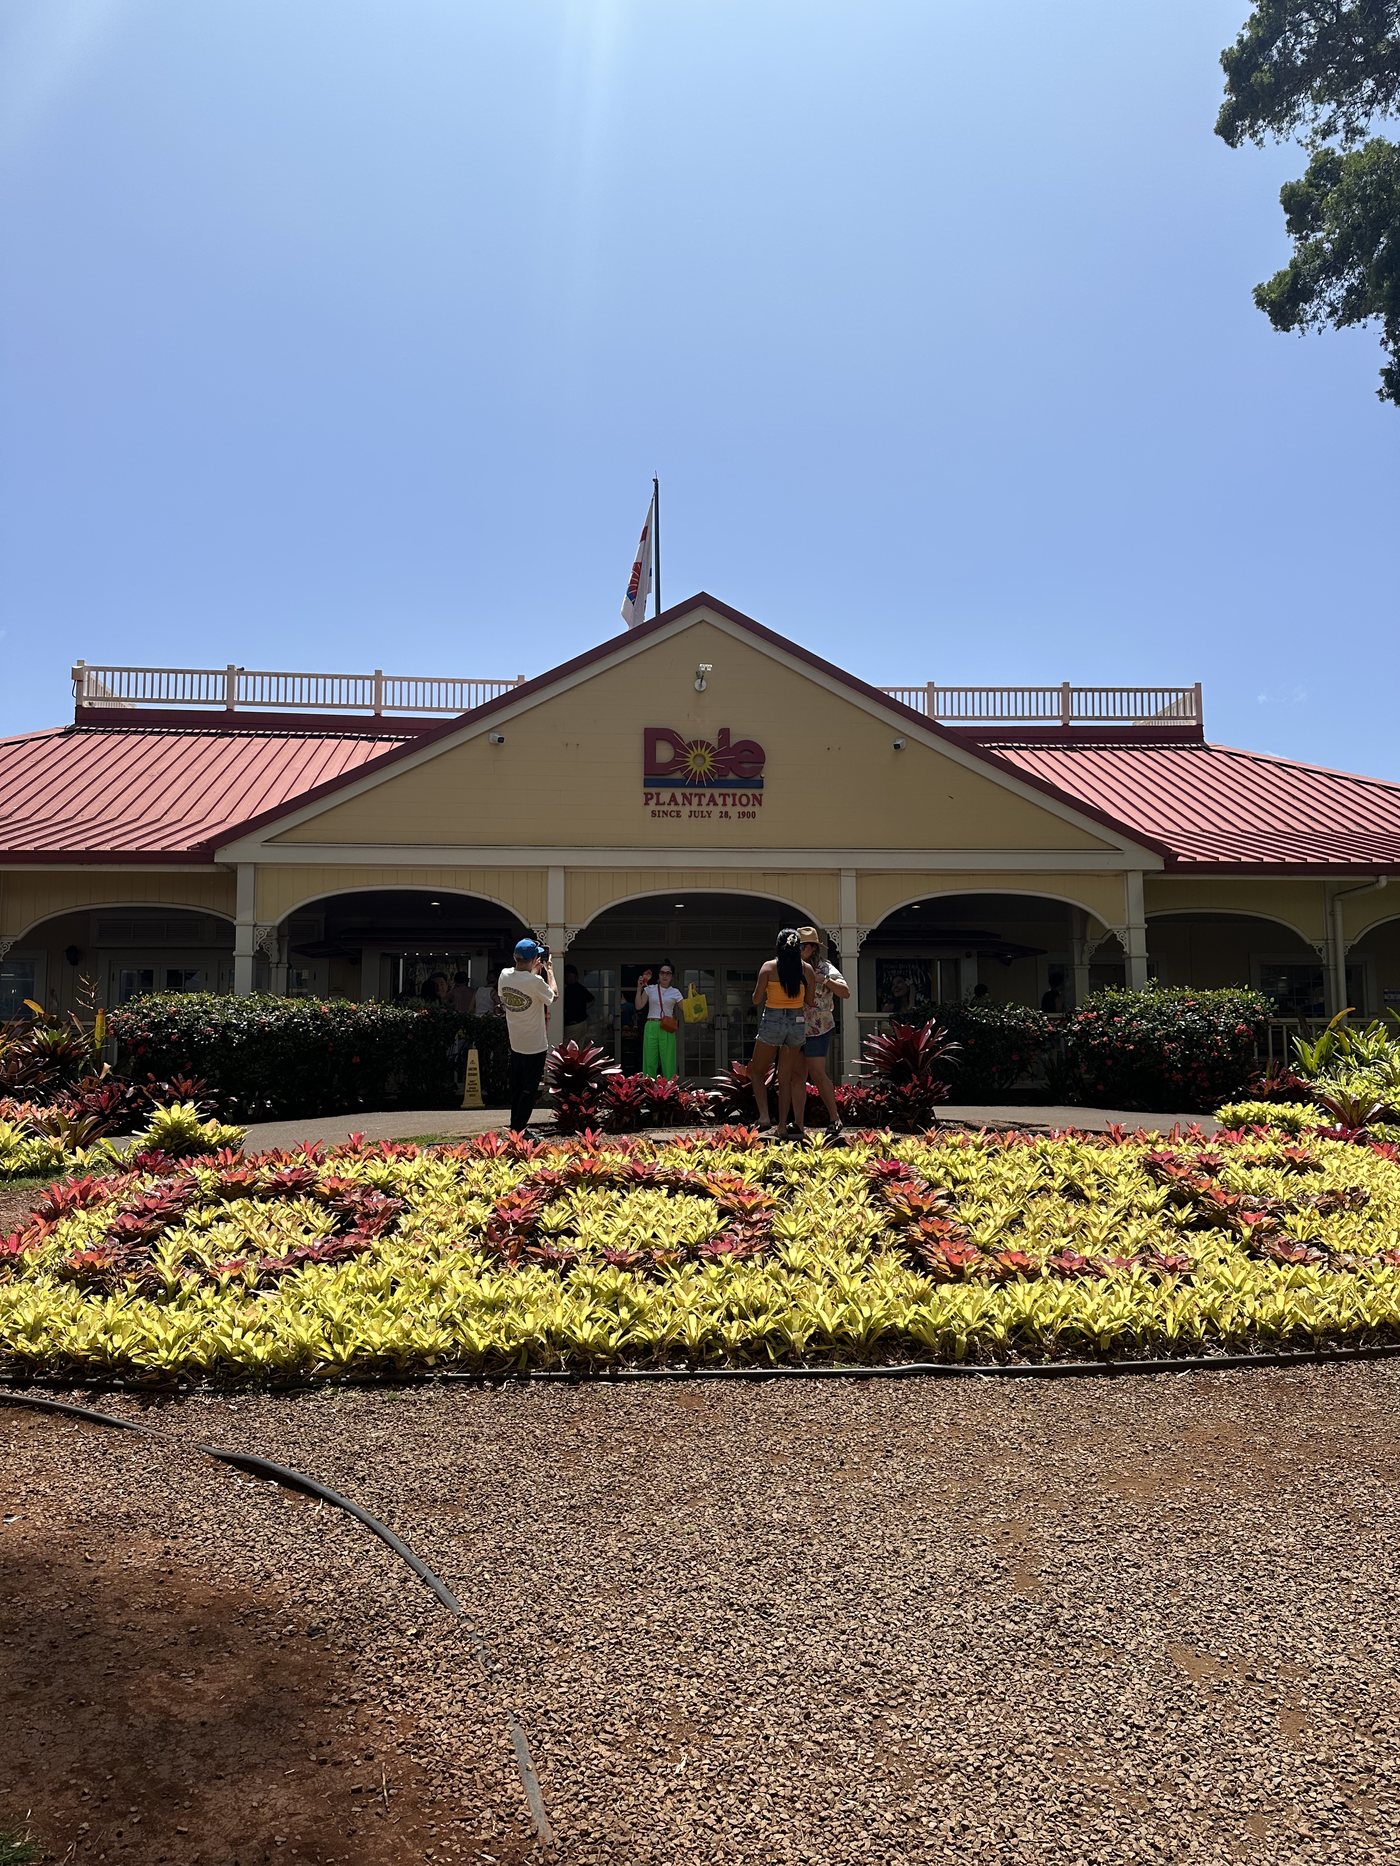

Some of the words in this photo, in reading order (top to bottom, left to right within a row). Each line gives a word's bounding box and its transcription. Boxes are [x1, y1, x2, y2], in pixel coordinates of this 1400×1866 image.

[644, 727, 766, 782] Dole
[643, 792, 763, 807] PLANTATION
[651, 810, 682, 818] SINCE
[688, 810, 713, 818] JULY
[719, 811, 732, 820] 28,
[737, 811, 756, 819] 1900
